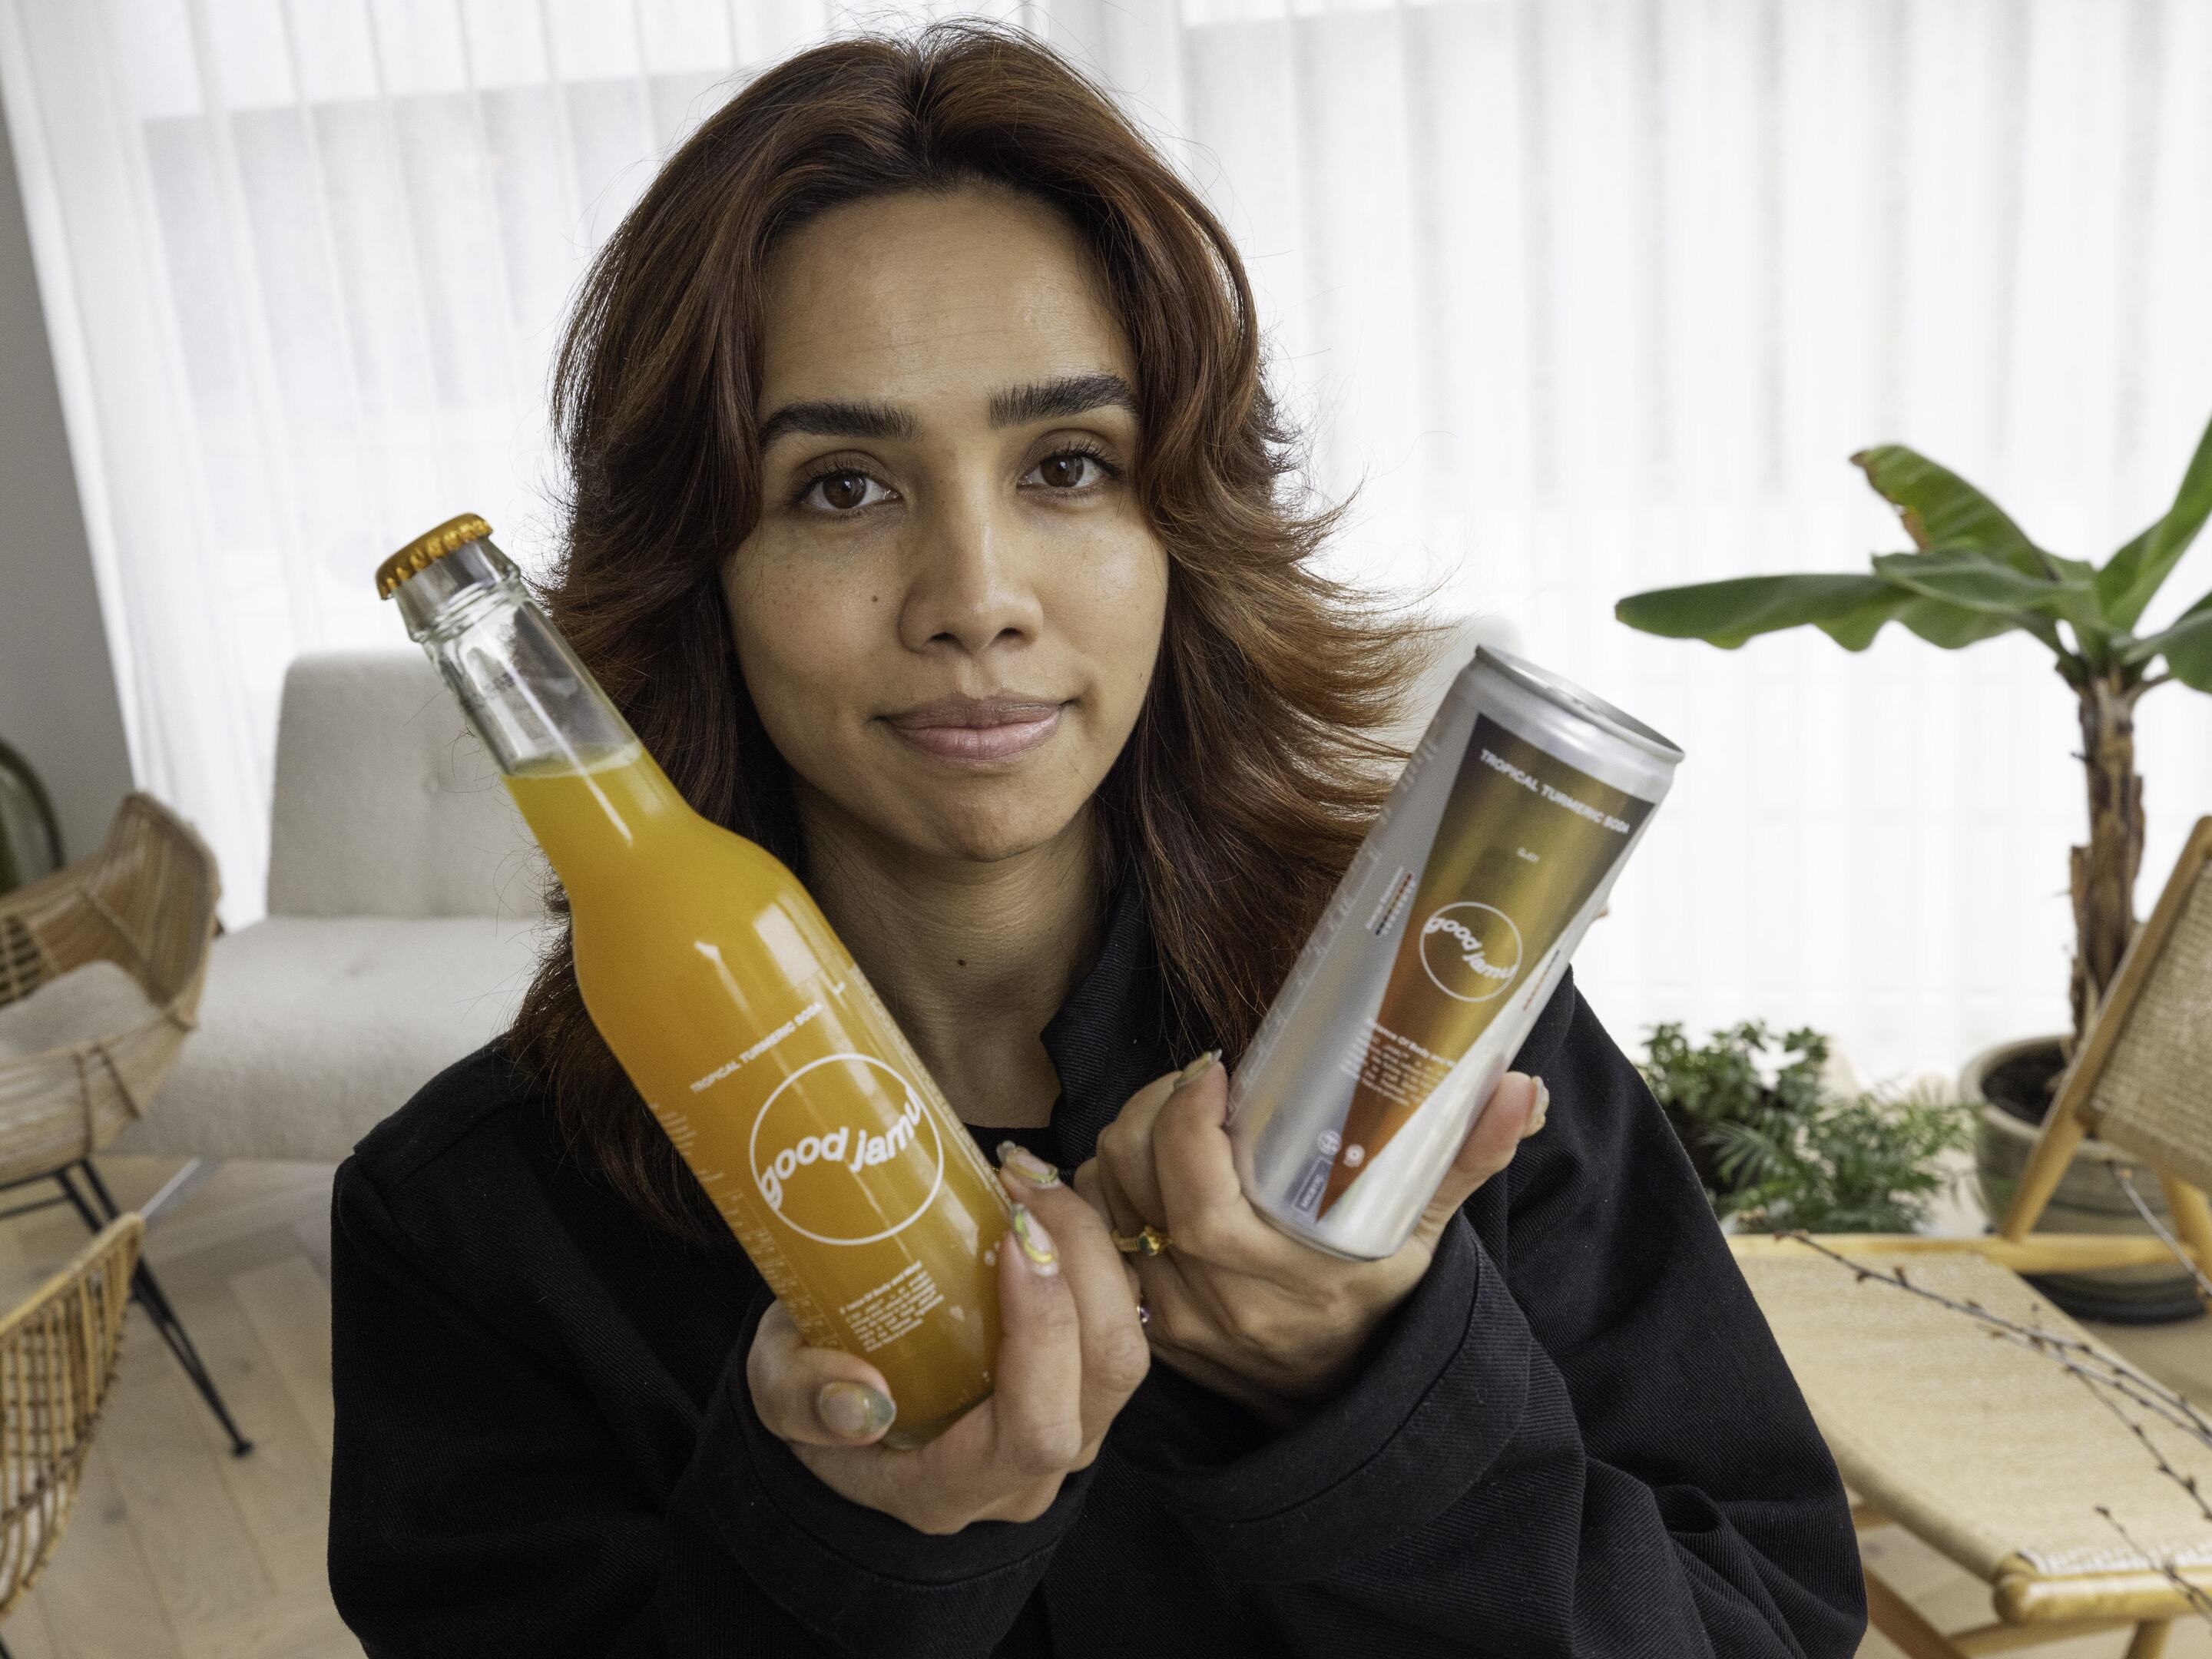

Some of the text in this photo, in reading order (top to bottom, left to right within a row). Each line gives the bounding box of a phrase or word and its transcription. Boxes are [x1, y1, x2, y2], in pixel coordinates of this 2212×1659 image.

[1480, 749, 1538, 792] TROPICAL
[1541, 784, 1605, 823] TURMERIC
[1424, 917, 1483, 951] good
[690, 1060, 741, 1093] TROPICAL
[739, 1020, 796, 1064] TURMERIC
[760, 1126, 849, 1210] good
[849, 1086, 921, 1173] jamu
